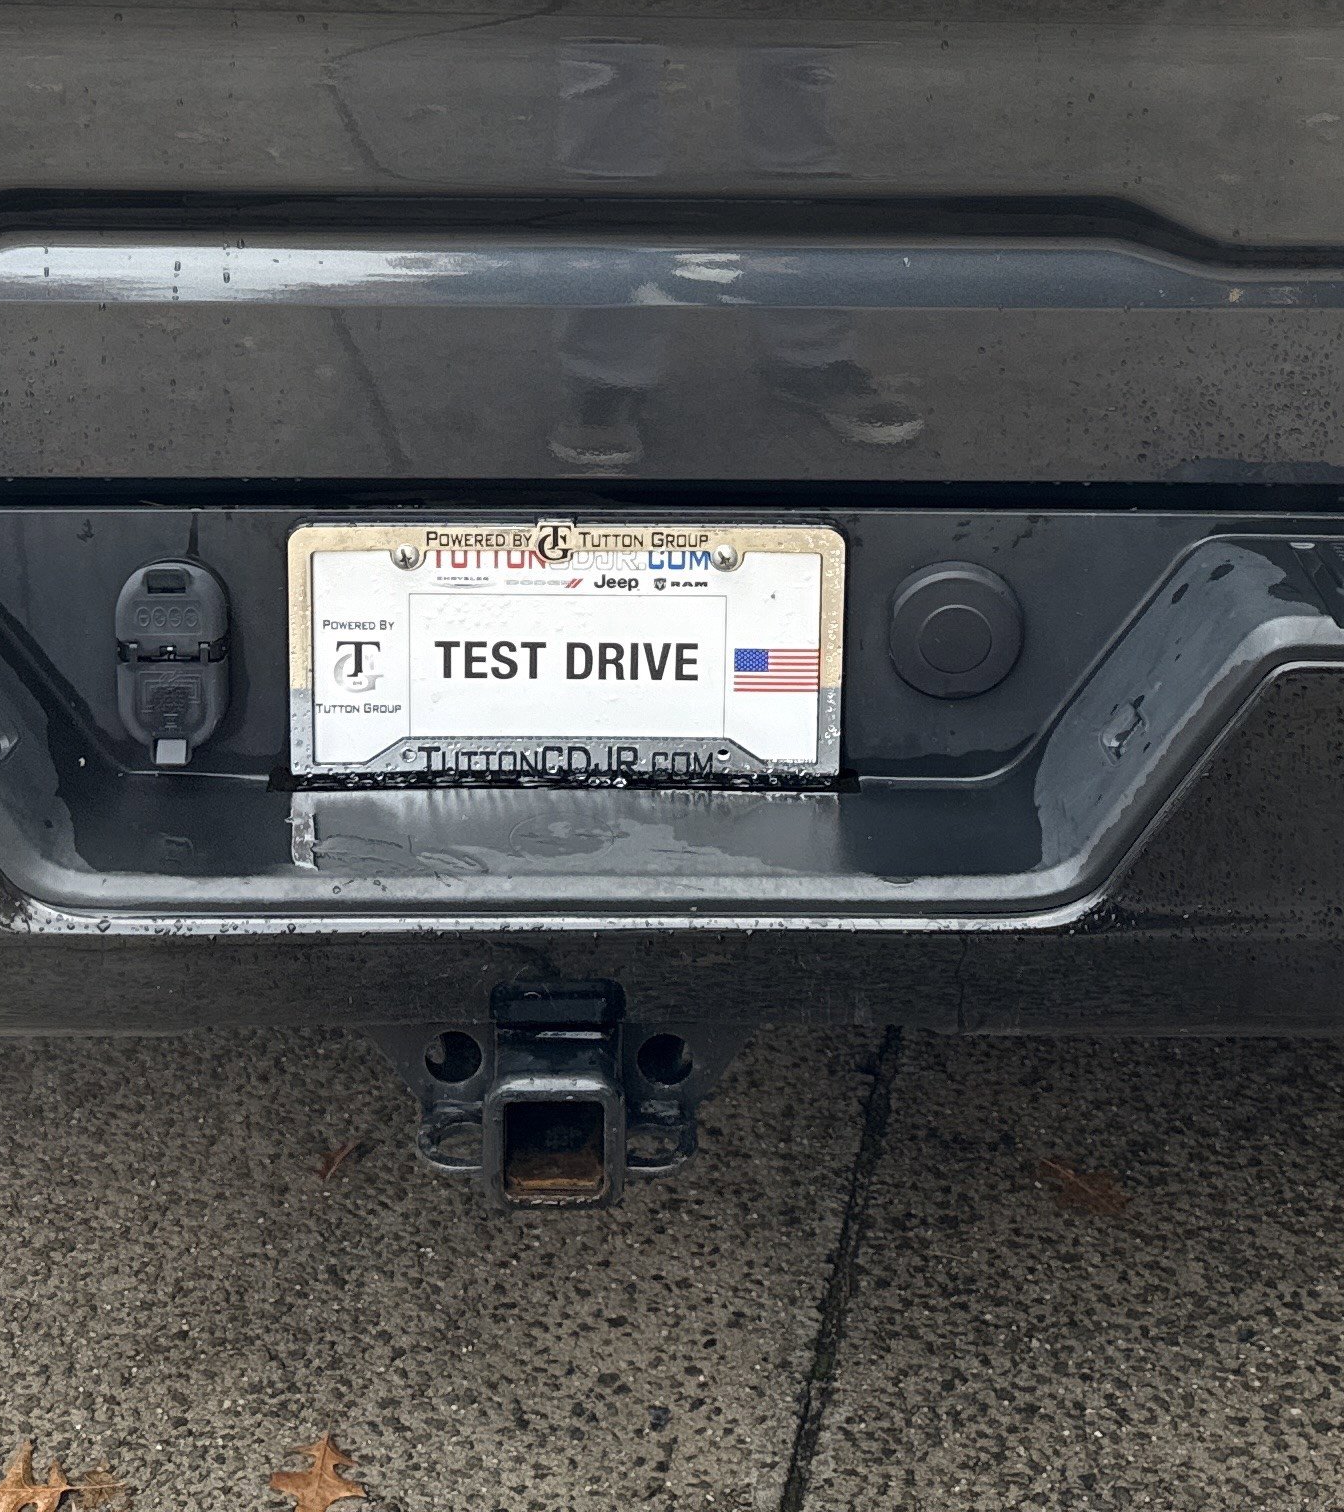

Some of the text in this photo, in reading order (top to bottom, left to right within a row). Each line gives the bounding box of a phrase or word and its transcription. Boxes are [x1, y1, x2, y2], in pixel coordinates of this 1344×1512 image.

[426, 531, 532, 547] POWERED BY
[578, 531, 709, 548] TUTTON GROUP
[593, 574, 639, 591] Jeep
[322, 619, 376, 630] POWERED
[434, 640, 699, 681] TEST DRIVE
[316, 702, 402, 714] TUTTON GROUP
